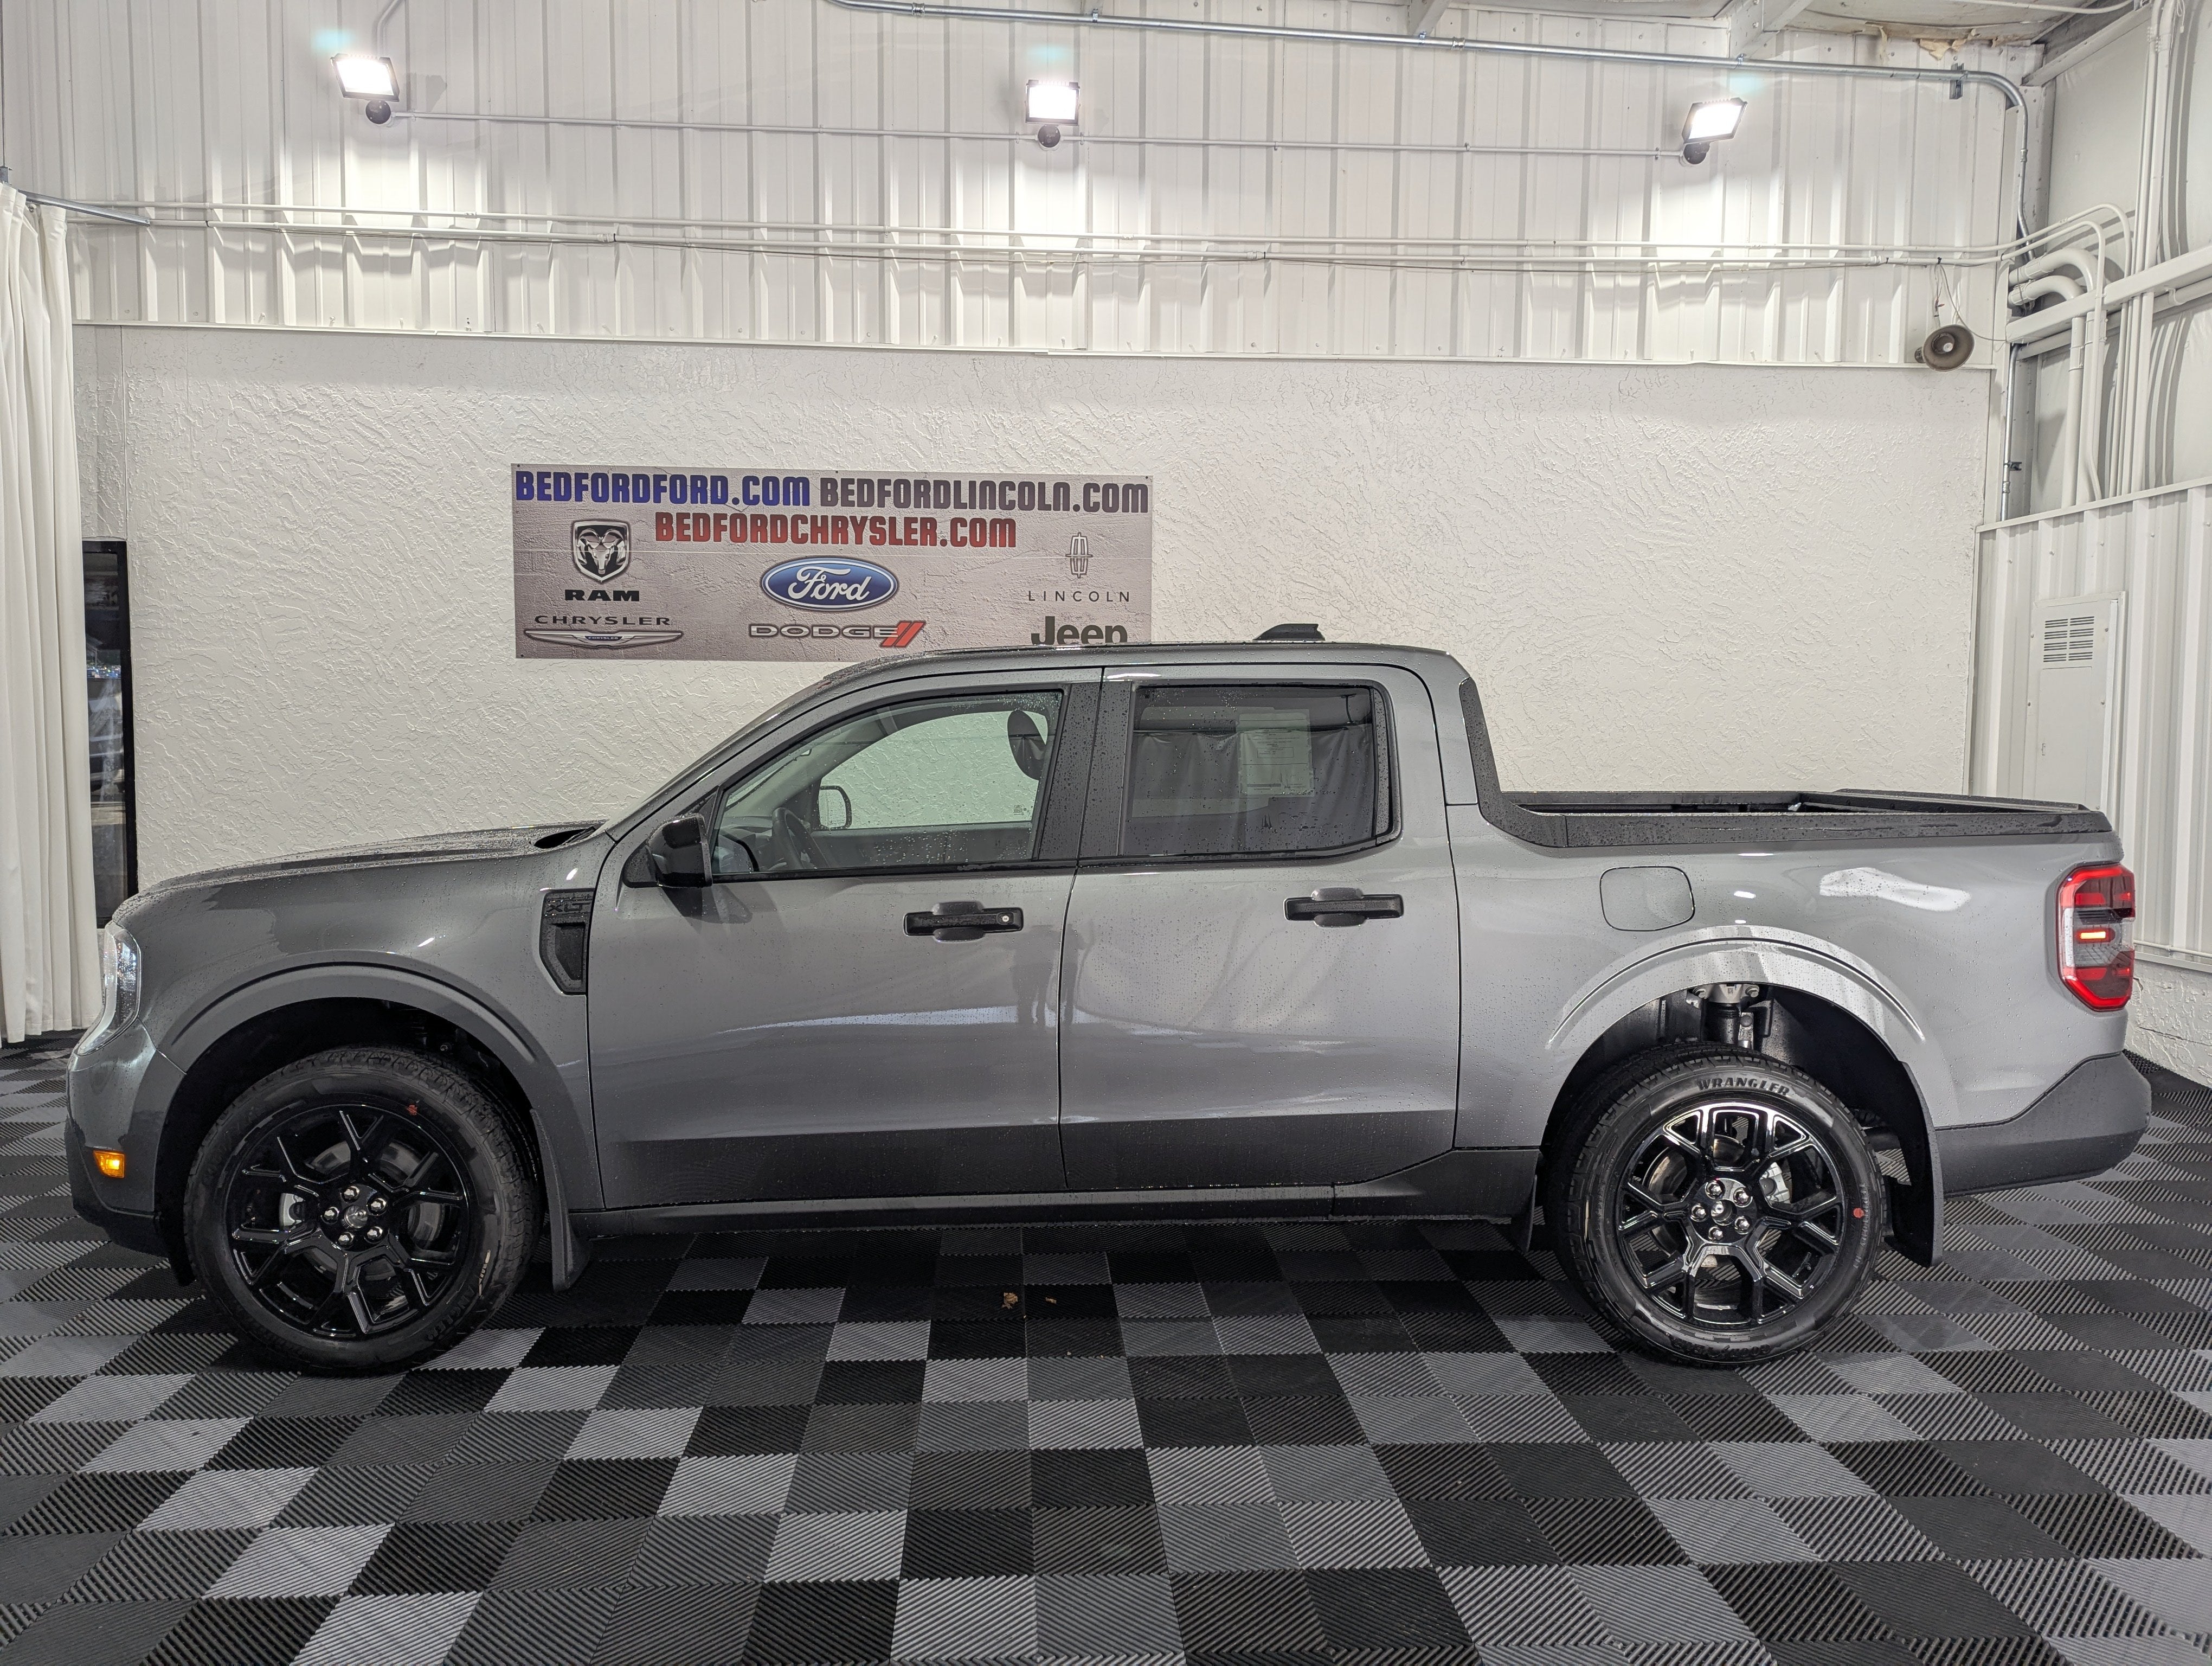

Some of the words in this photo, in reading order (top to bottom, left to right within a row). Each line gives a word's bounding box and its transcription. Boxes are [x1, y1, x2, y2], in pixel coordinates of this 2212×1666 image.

[516, 471, 811, 507] BEDFORDFORD.COM
[820, 477, 1148, 513] BEDFORDLINCOLN.COM
[655, 511, 1017, 548] BEDFORDCHRYSLER.COM
[788, 566, 872, 600] Ford
[565, 589, 640, 602] RAM
[1028, 590, 1129, 602] LINCOLN
[535, 615, 670, 625] CHRYSLER
[750, 625, 898, 638] DODGE
[546, 902, 590, 912] XLT
[1696, 1077, 1790, 1095] WRANGLER
